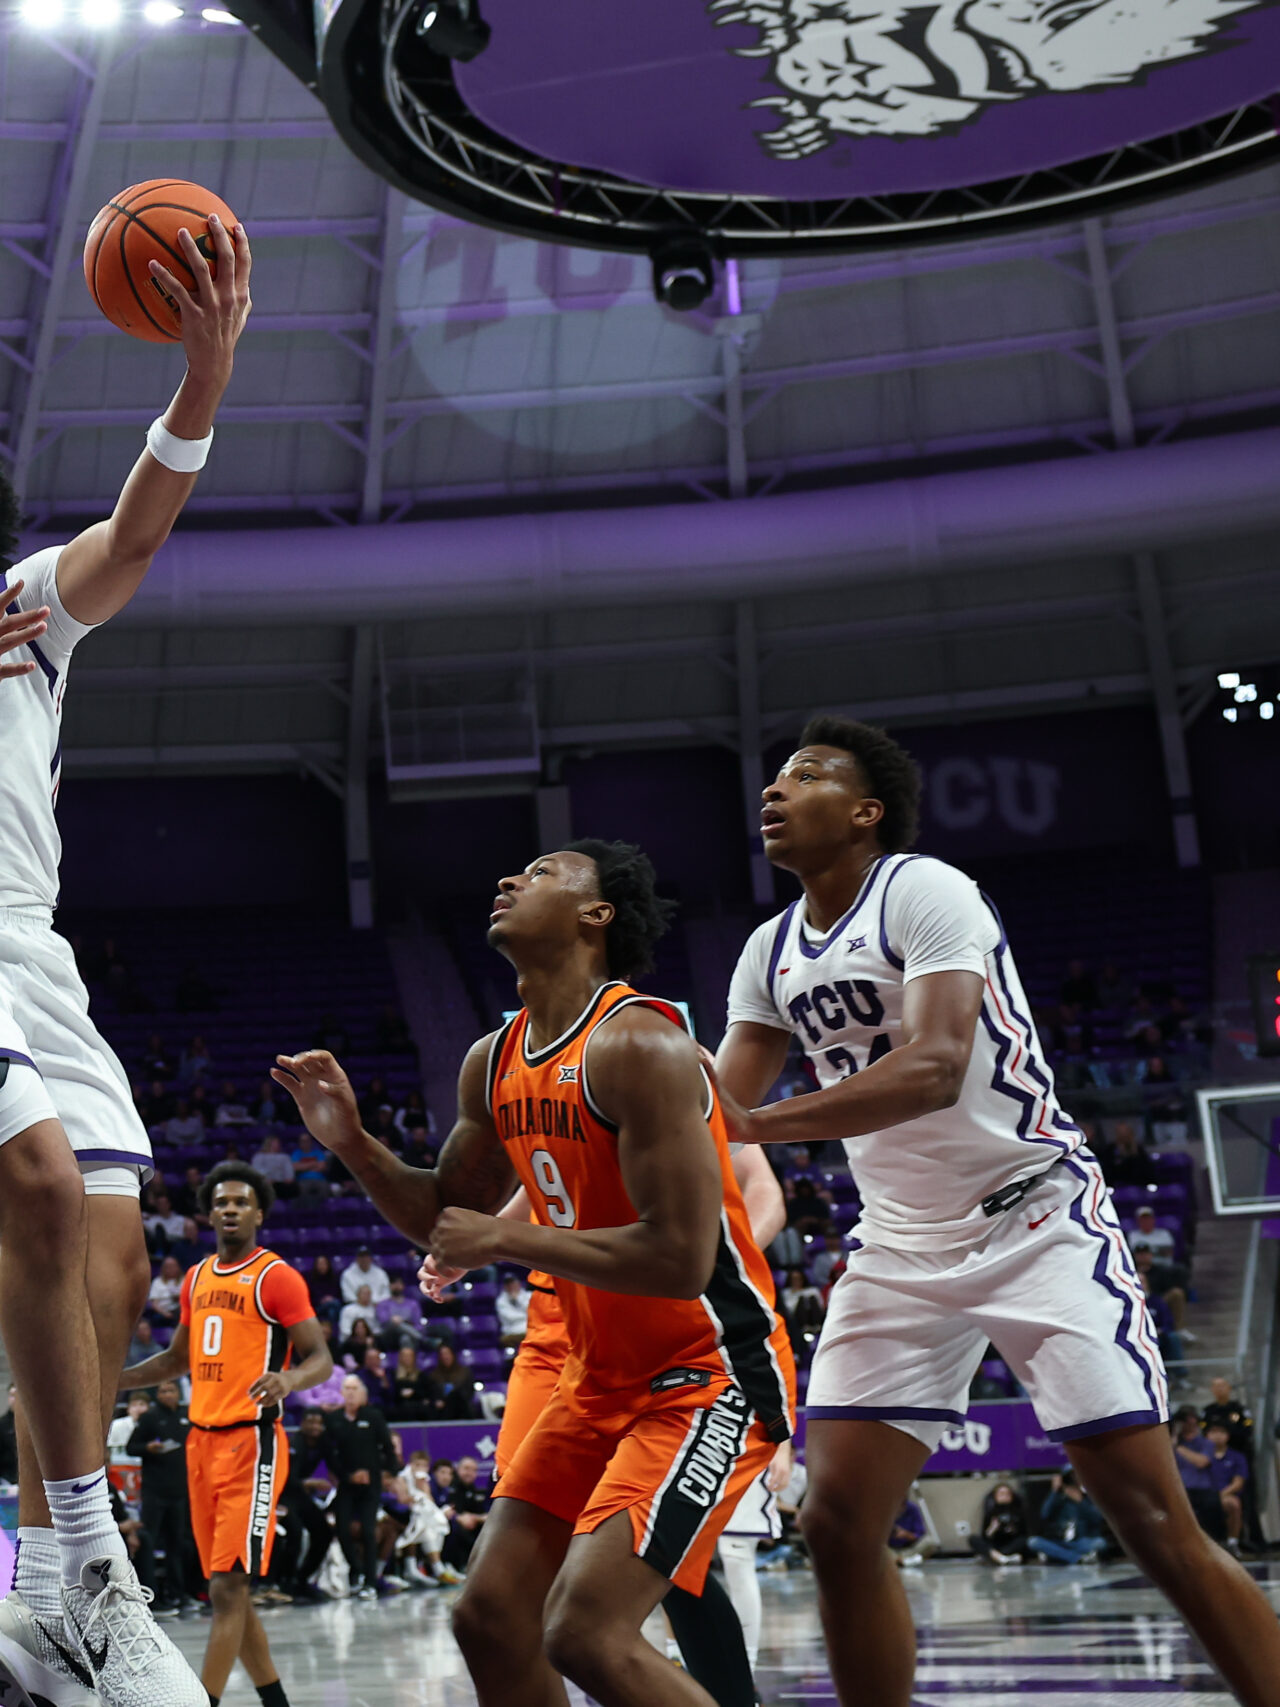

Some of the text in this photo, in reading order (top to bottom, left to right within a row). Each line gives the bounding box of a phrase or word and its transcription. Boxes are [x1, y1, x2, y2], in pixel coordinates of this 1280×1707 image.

[929, 756, 1061, 836] CU
[788, 979, 885, 1045] TCU
[531, 1149, 576, 1228] 9
[202, 1315, 223, 1356] 0
[677, 1389, 747, 1507] COWBOYS
[941, 1420, 992, 1455] CU
[253, 1464, 272, 1537] COWBOYS
